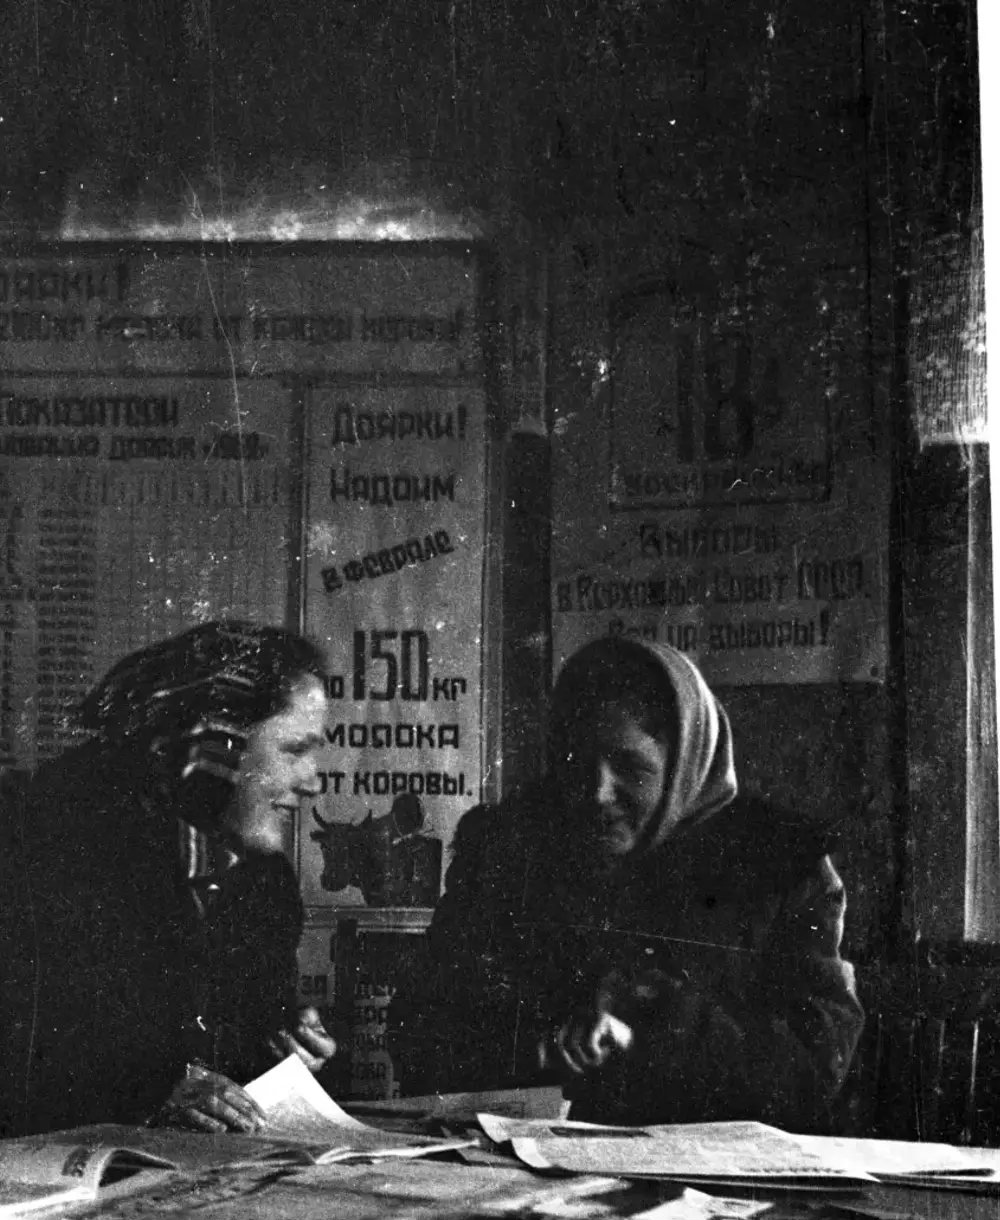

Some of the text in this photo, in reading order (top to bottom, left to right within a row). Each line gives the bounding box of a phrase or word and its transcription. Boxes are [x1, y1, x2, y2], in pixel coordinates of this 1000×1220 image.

[332, 403, 468, 445] Доярки!
[330, 468, 456, 507] Надоим
[352, 629, 428, 701] 150
